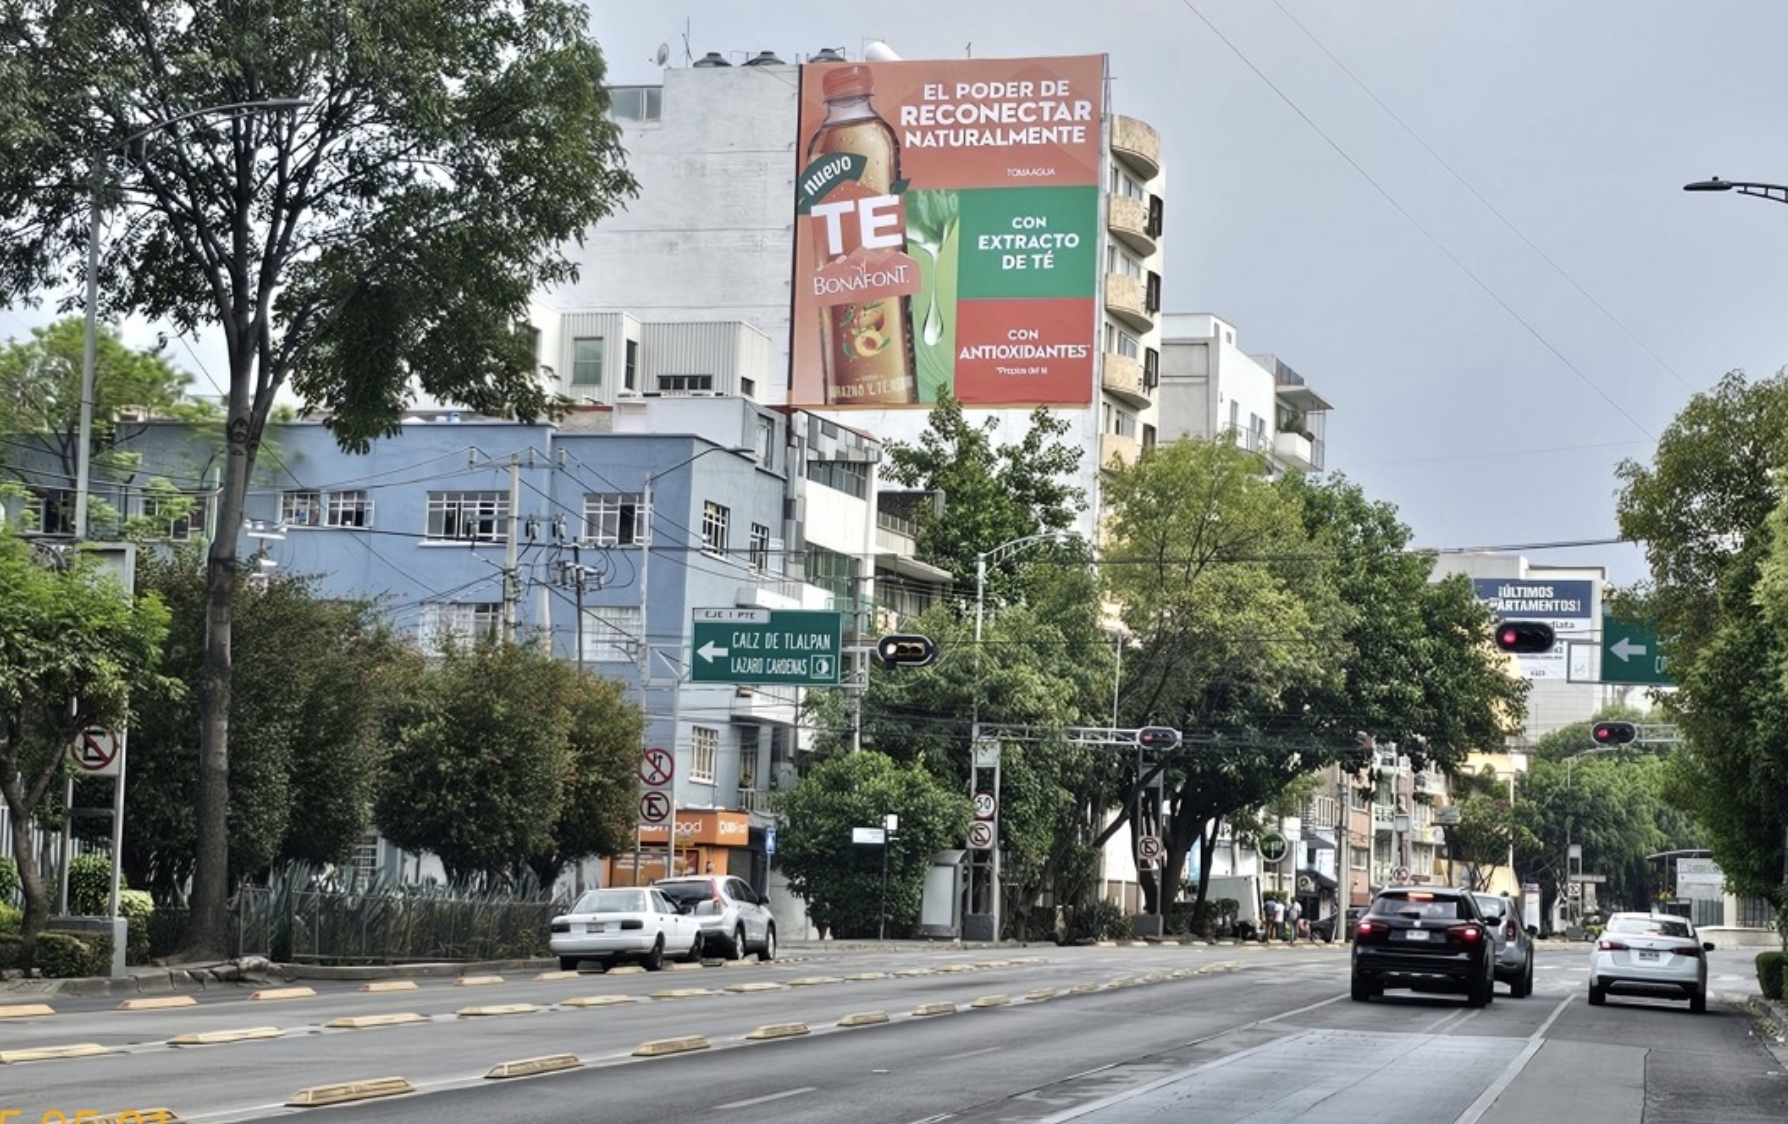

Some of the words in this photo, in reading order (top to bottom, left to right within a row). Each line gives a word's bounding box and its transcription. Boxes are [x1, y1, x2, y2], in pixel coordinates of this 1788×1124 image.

[924, 83, 949, 101] EL
[956, 81, 1034, 100] PODER
[1041, 80, 1069, 98] DE
[901, 100, 1092, 126] RECONECTAR
[905, 126, 1086, 148] NATURALMENTE
[804, 156, 852, 196] nuevo
[1012, 216, 1047, 229] CON
[978, 233, 1080, 250] EXTRACTO
[1002, 255, 1027, 270] DE
[1031, 250, 1054, 269] TÉ
[814, 265, 909, 295] BONAFONT
[1007, 329, 1039, 341] CON
[732, 632, 759, 649] CALZ
[765, 632, 779, 649] DE
[785, 632, 831, 650] TLALPAN
[731, 657, 763, 674] LAZARO
[766, 658, 807, 675] CARDENAS
